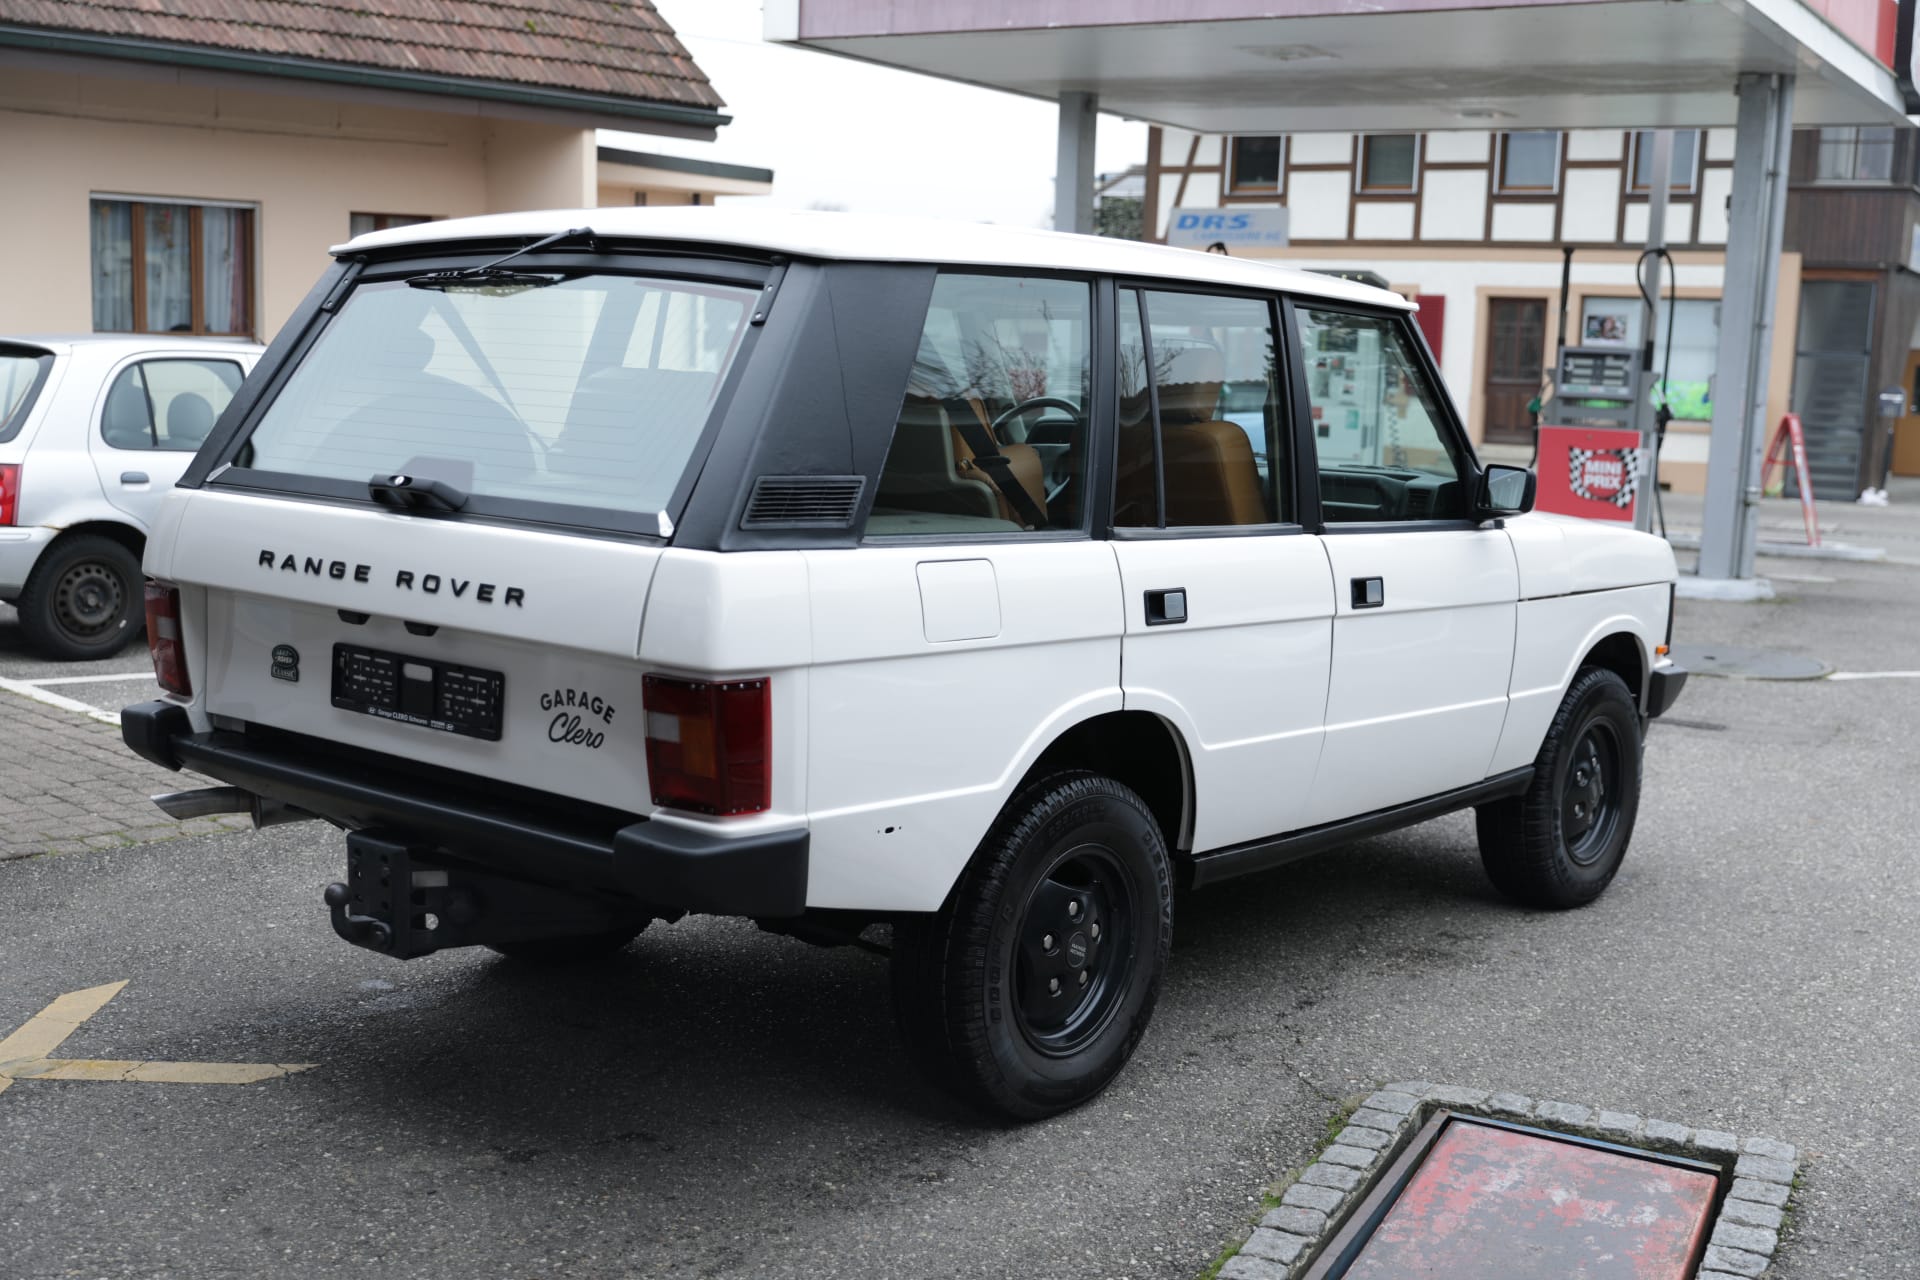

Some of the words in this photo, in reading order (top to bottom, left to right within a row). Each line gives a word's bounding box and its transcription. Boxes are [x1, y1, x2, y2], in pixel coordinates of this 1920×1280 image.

[1176, 214, 1251, 231] DRS
[1583, 473, 1622, 489] PRIX
[1584, 460, 1622, 475] MINI
[258, 549, 371, 583] RANGE
[396, 570, 525, 608] ROVER
[540, 688, 616, 725] GARAGE
[548, 712, 605, 749] Clero
